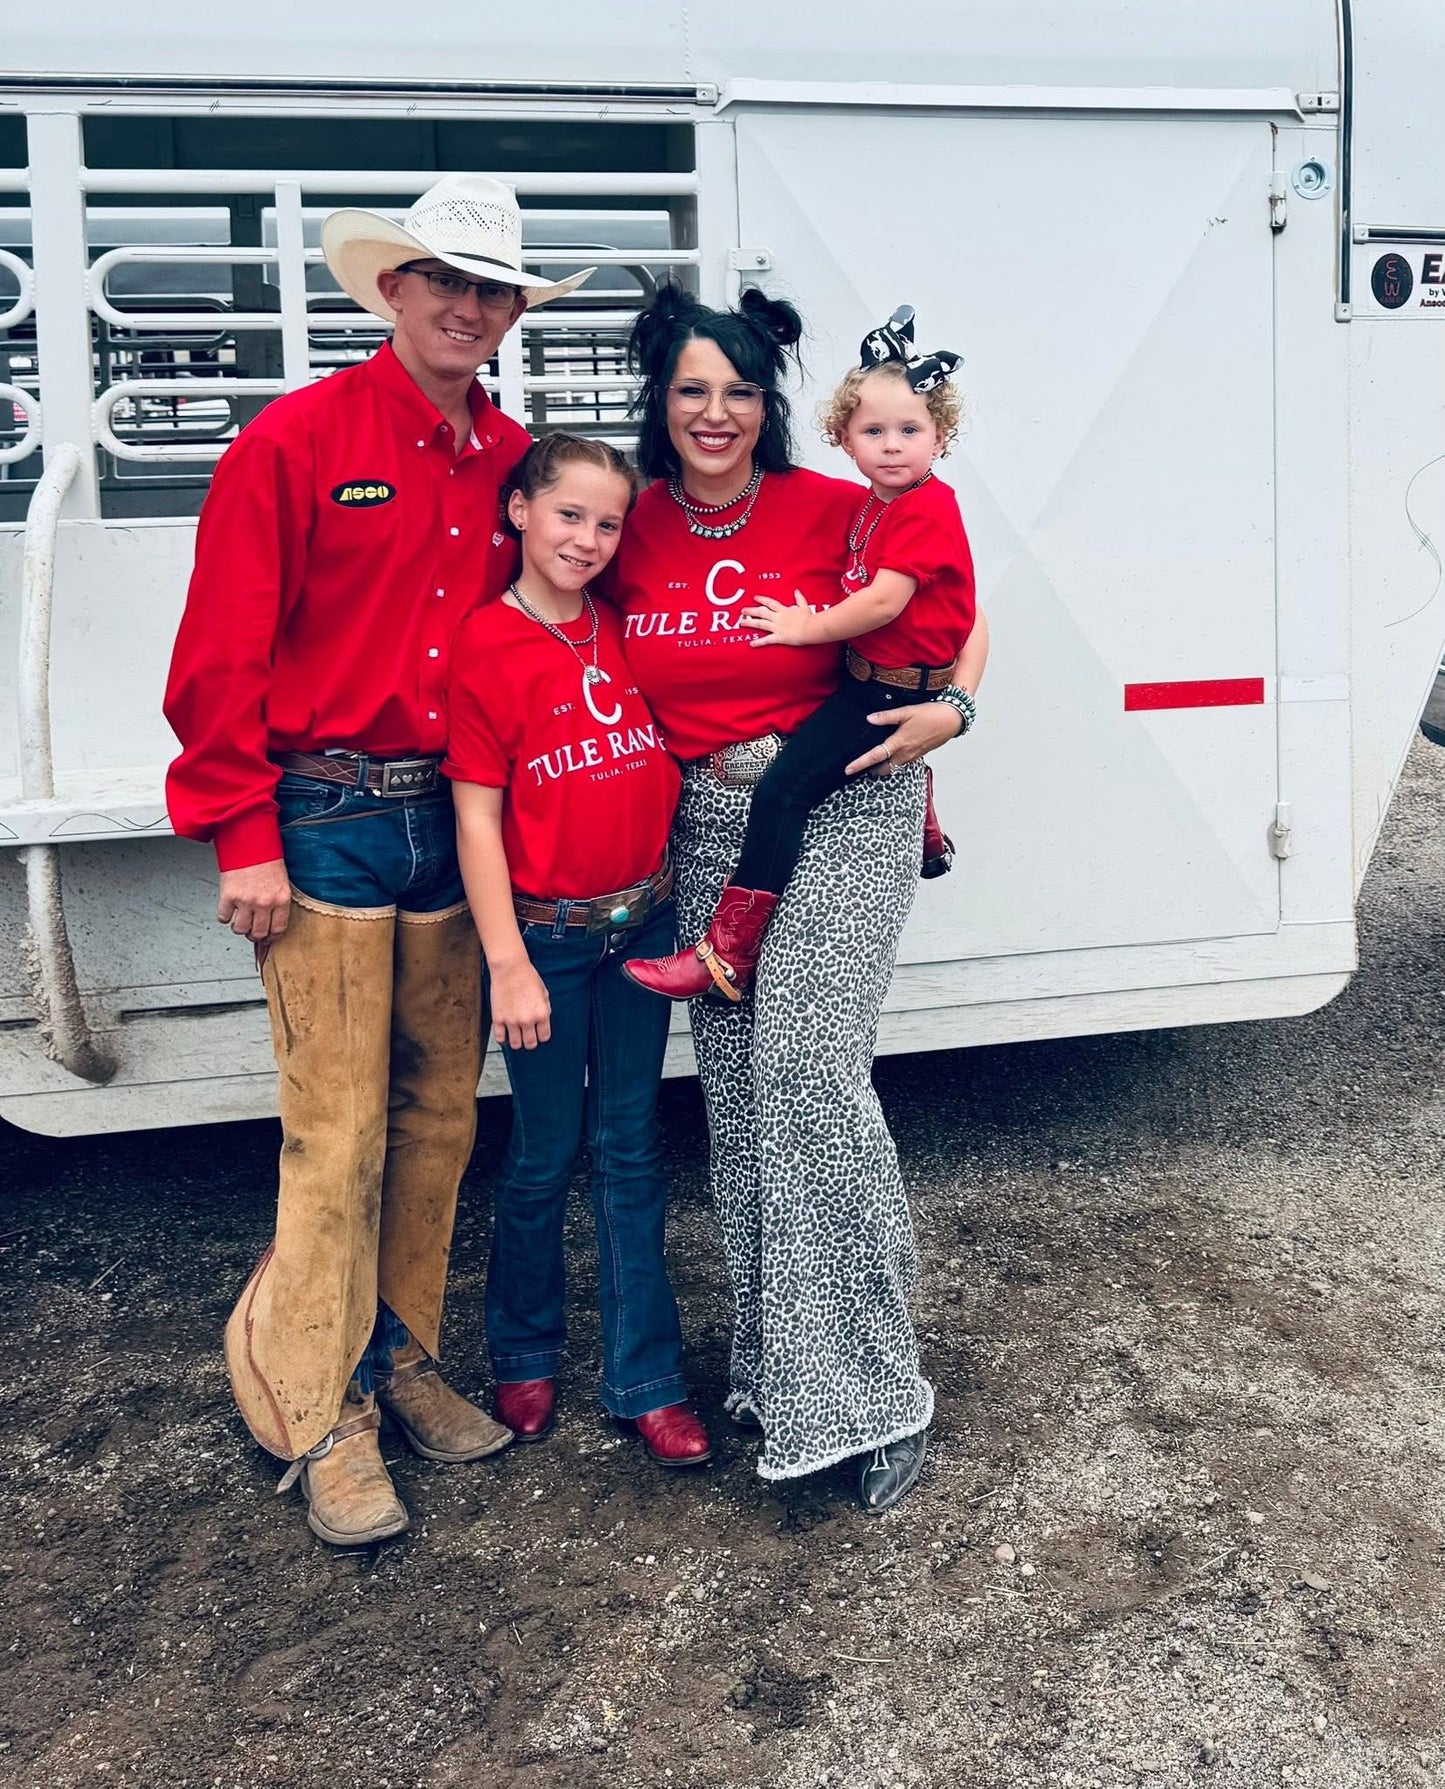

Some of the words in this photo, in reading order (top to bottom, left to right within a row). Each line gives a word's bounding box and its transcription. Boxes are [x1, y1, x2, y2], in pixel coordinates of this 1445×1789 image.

[1428, 288, 1439, 298] by
[339, 485, 389, 501] ASCO
[668, 581, 691, 590] EST.
[705, 559, 746, 607] C
[758, 572, 781, 581] 1953
[624, 610, 699, 639] TULE
[722, 632, 760, 644] TEXAS
[553, 702, 576, 716] EST.
[582, 668, 622, 725] C
[527, 738, 604, 786] TULE
